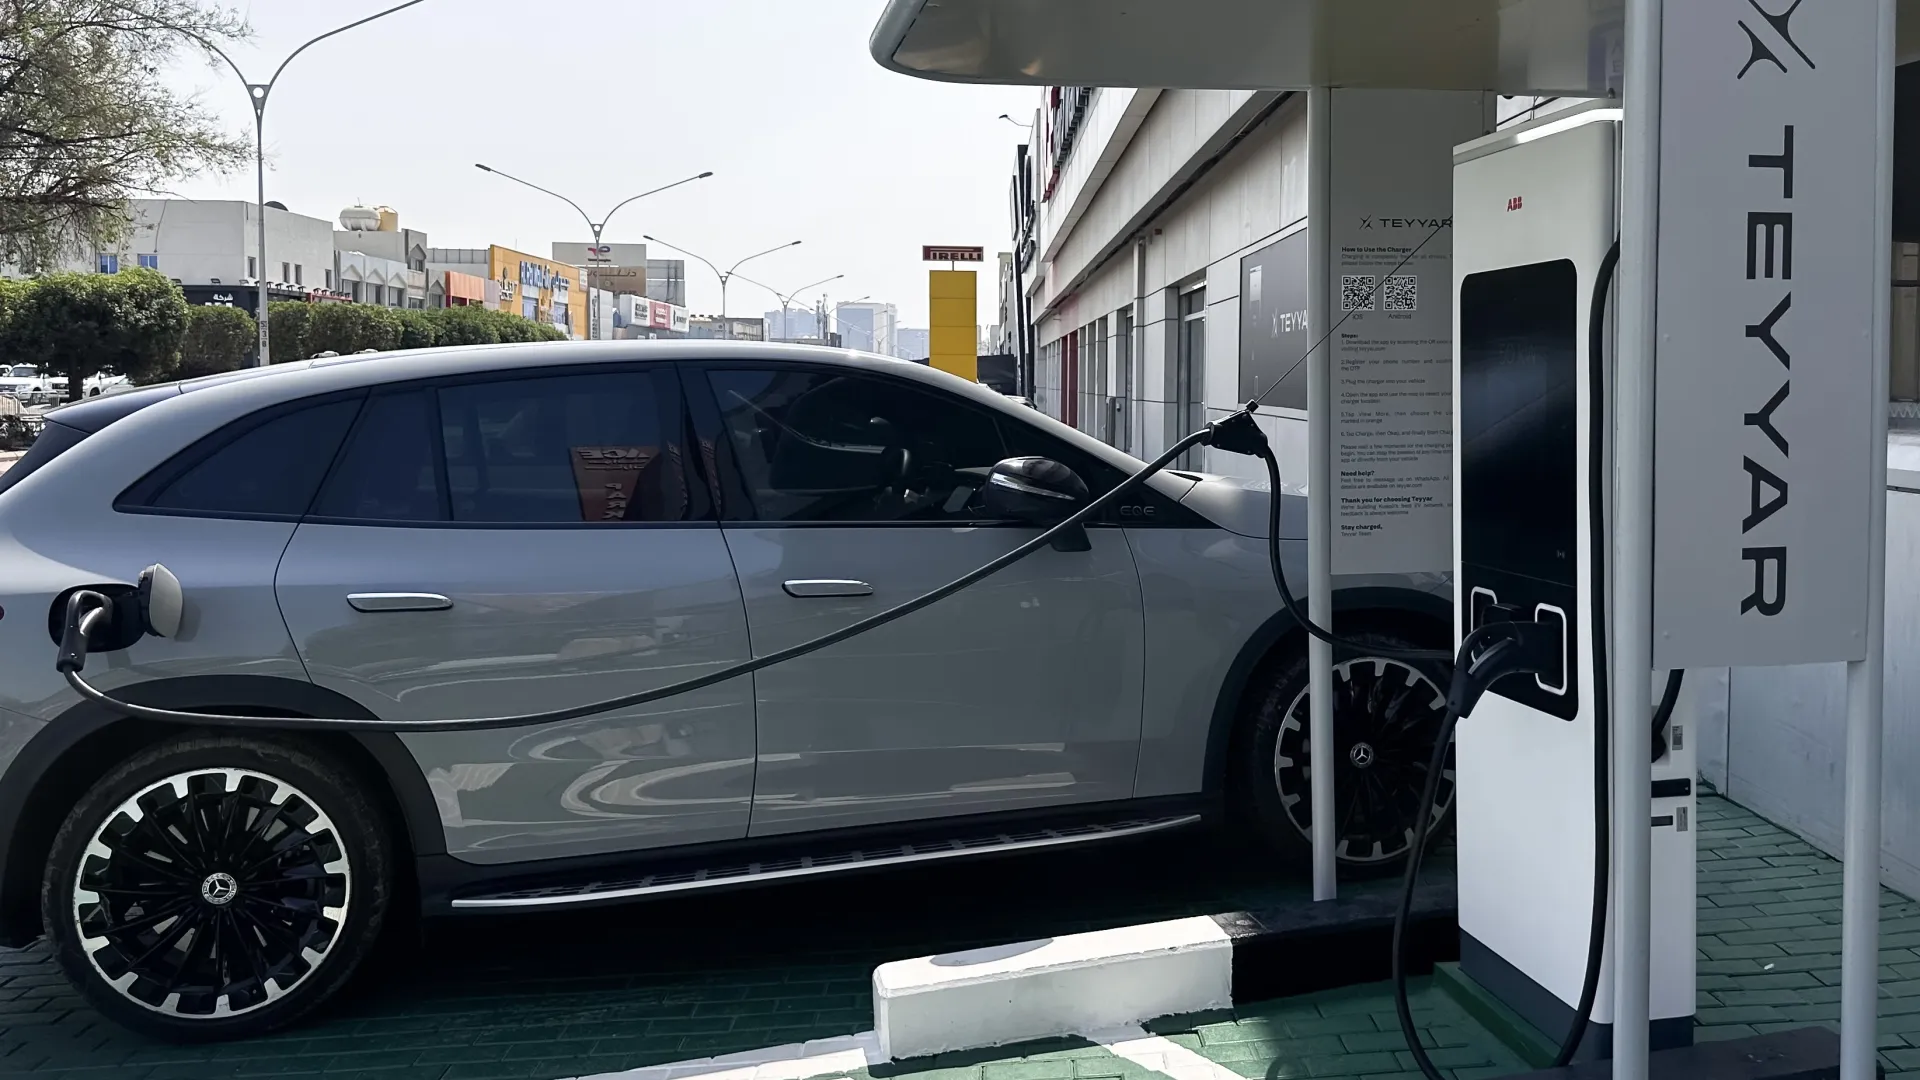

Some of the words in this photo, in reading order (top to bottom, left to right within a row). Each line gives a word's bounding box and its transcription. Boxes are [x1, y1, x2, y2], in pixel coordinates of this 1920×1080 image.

[1507, 196, 1522, 212] ABB
[1379, 219, 1452, 228] TEYYAR
[1387, 246, 1412, 254] Charger
[1280, 310, 1308, 333] TEYYA
[1740, 125, 1794, 616] TEYYAR
[1120, 505, 1155, 515] EQE
